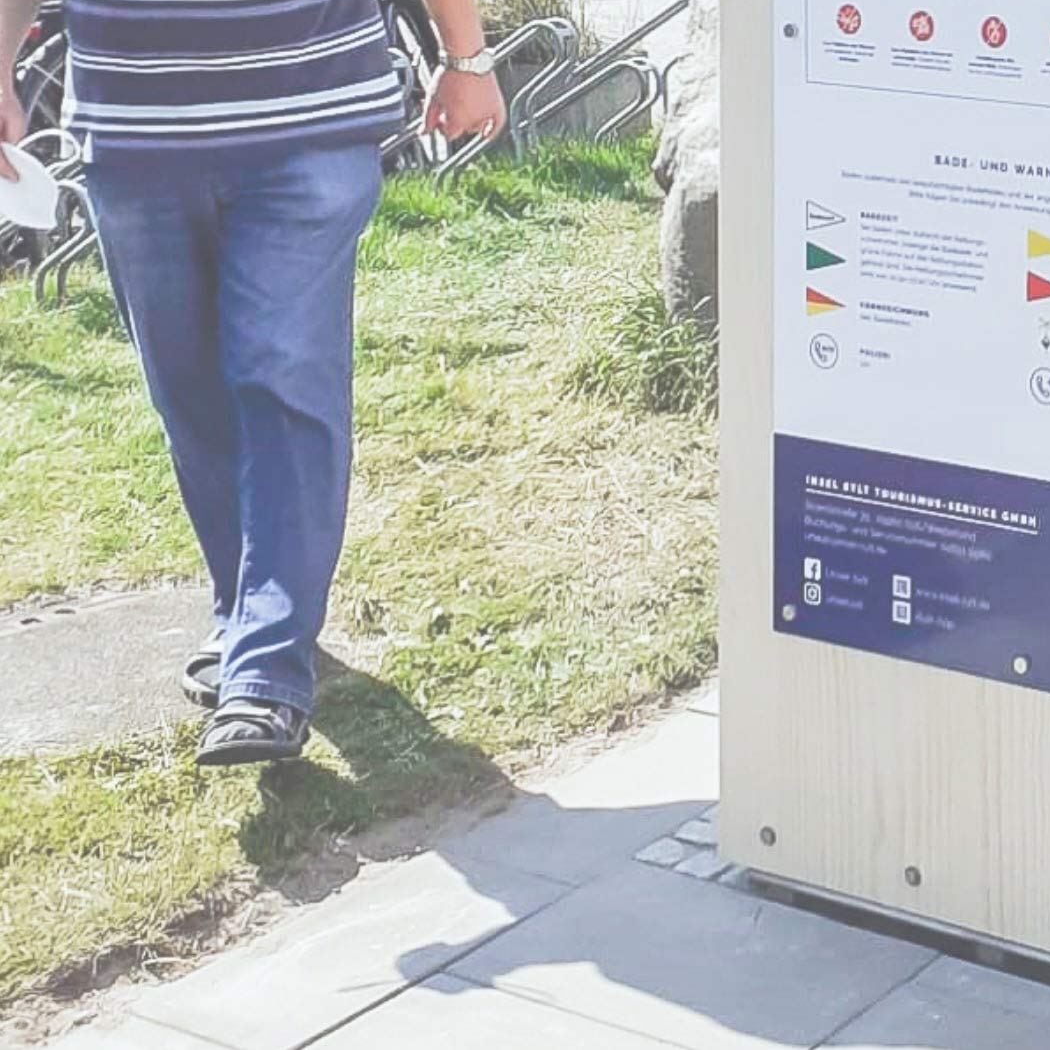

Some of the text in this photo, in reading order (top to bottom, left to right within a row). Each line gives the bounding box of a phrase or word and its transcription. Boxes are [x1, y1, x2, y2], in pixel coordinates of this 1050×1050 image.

[979, 159, 1008, 173] UND
[805, 474, 839, 490] INSEL
[843, 481, 870, 495] SYLT
